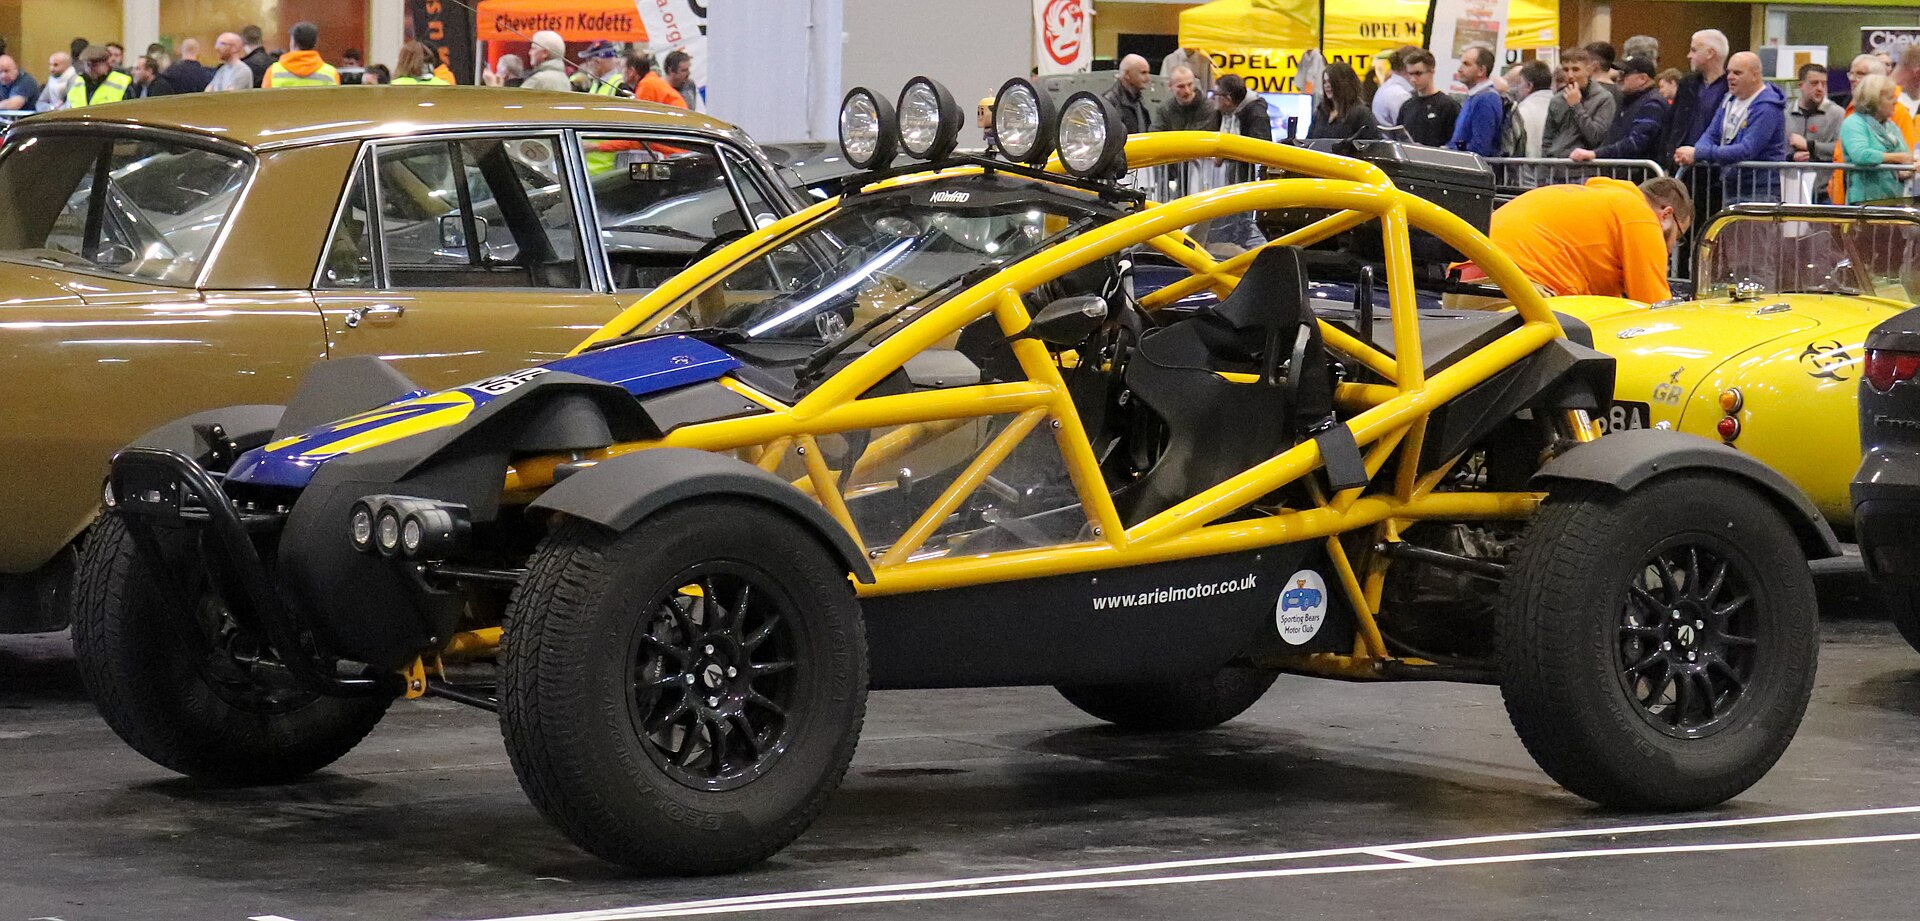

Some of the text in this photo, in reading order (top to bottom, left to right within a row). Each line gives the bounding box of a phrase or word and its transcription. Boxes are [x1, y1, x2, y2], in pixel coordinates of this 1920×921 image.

[495, 12, 632, 33] Chevettes n Kadetts
[1360, 22, 1400, 38] OPEL
[1210, 54, 1278, 69] OPEL
[929, 190, 970, 204] NOMAD
[1652, 382, 1683, 406] GB
[1093, 573, 1257, 610] www.arielmotor.co.uk
[1280, 613, 1320, 625] Sporting Bears
[1284, 624, 1314, 634] Motor Club
